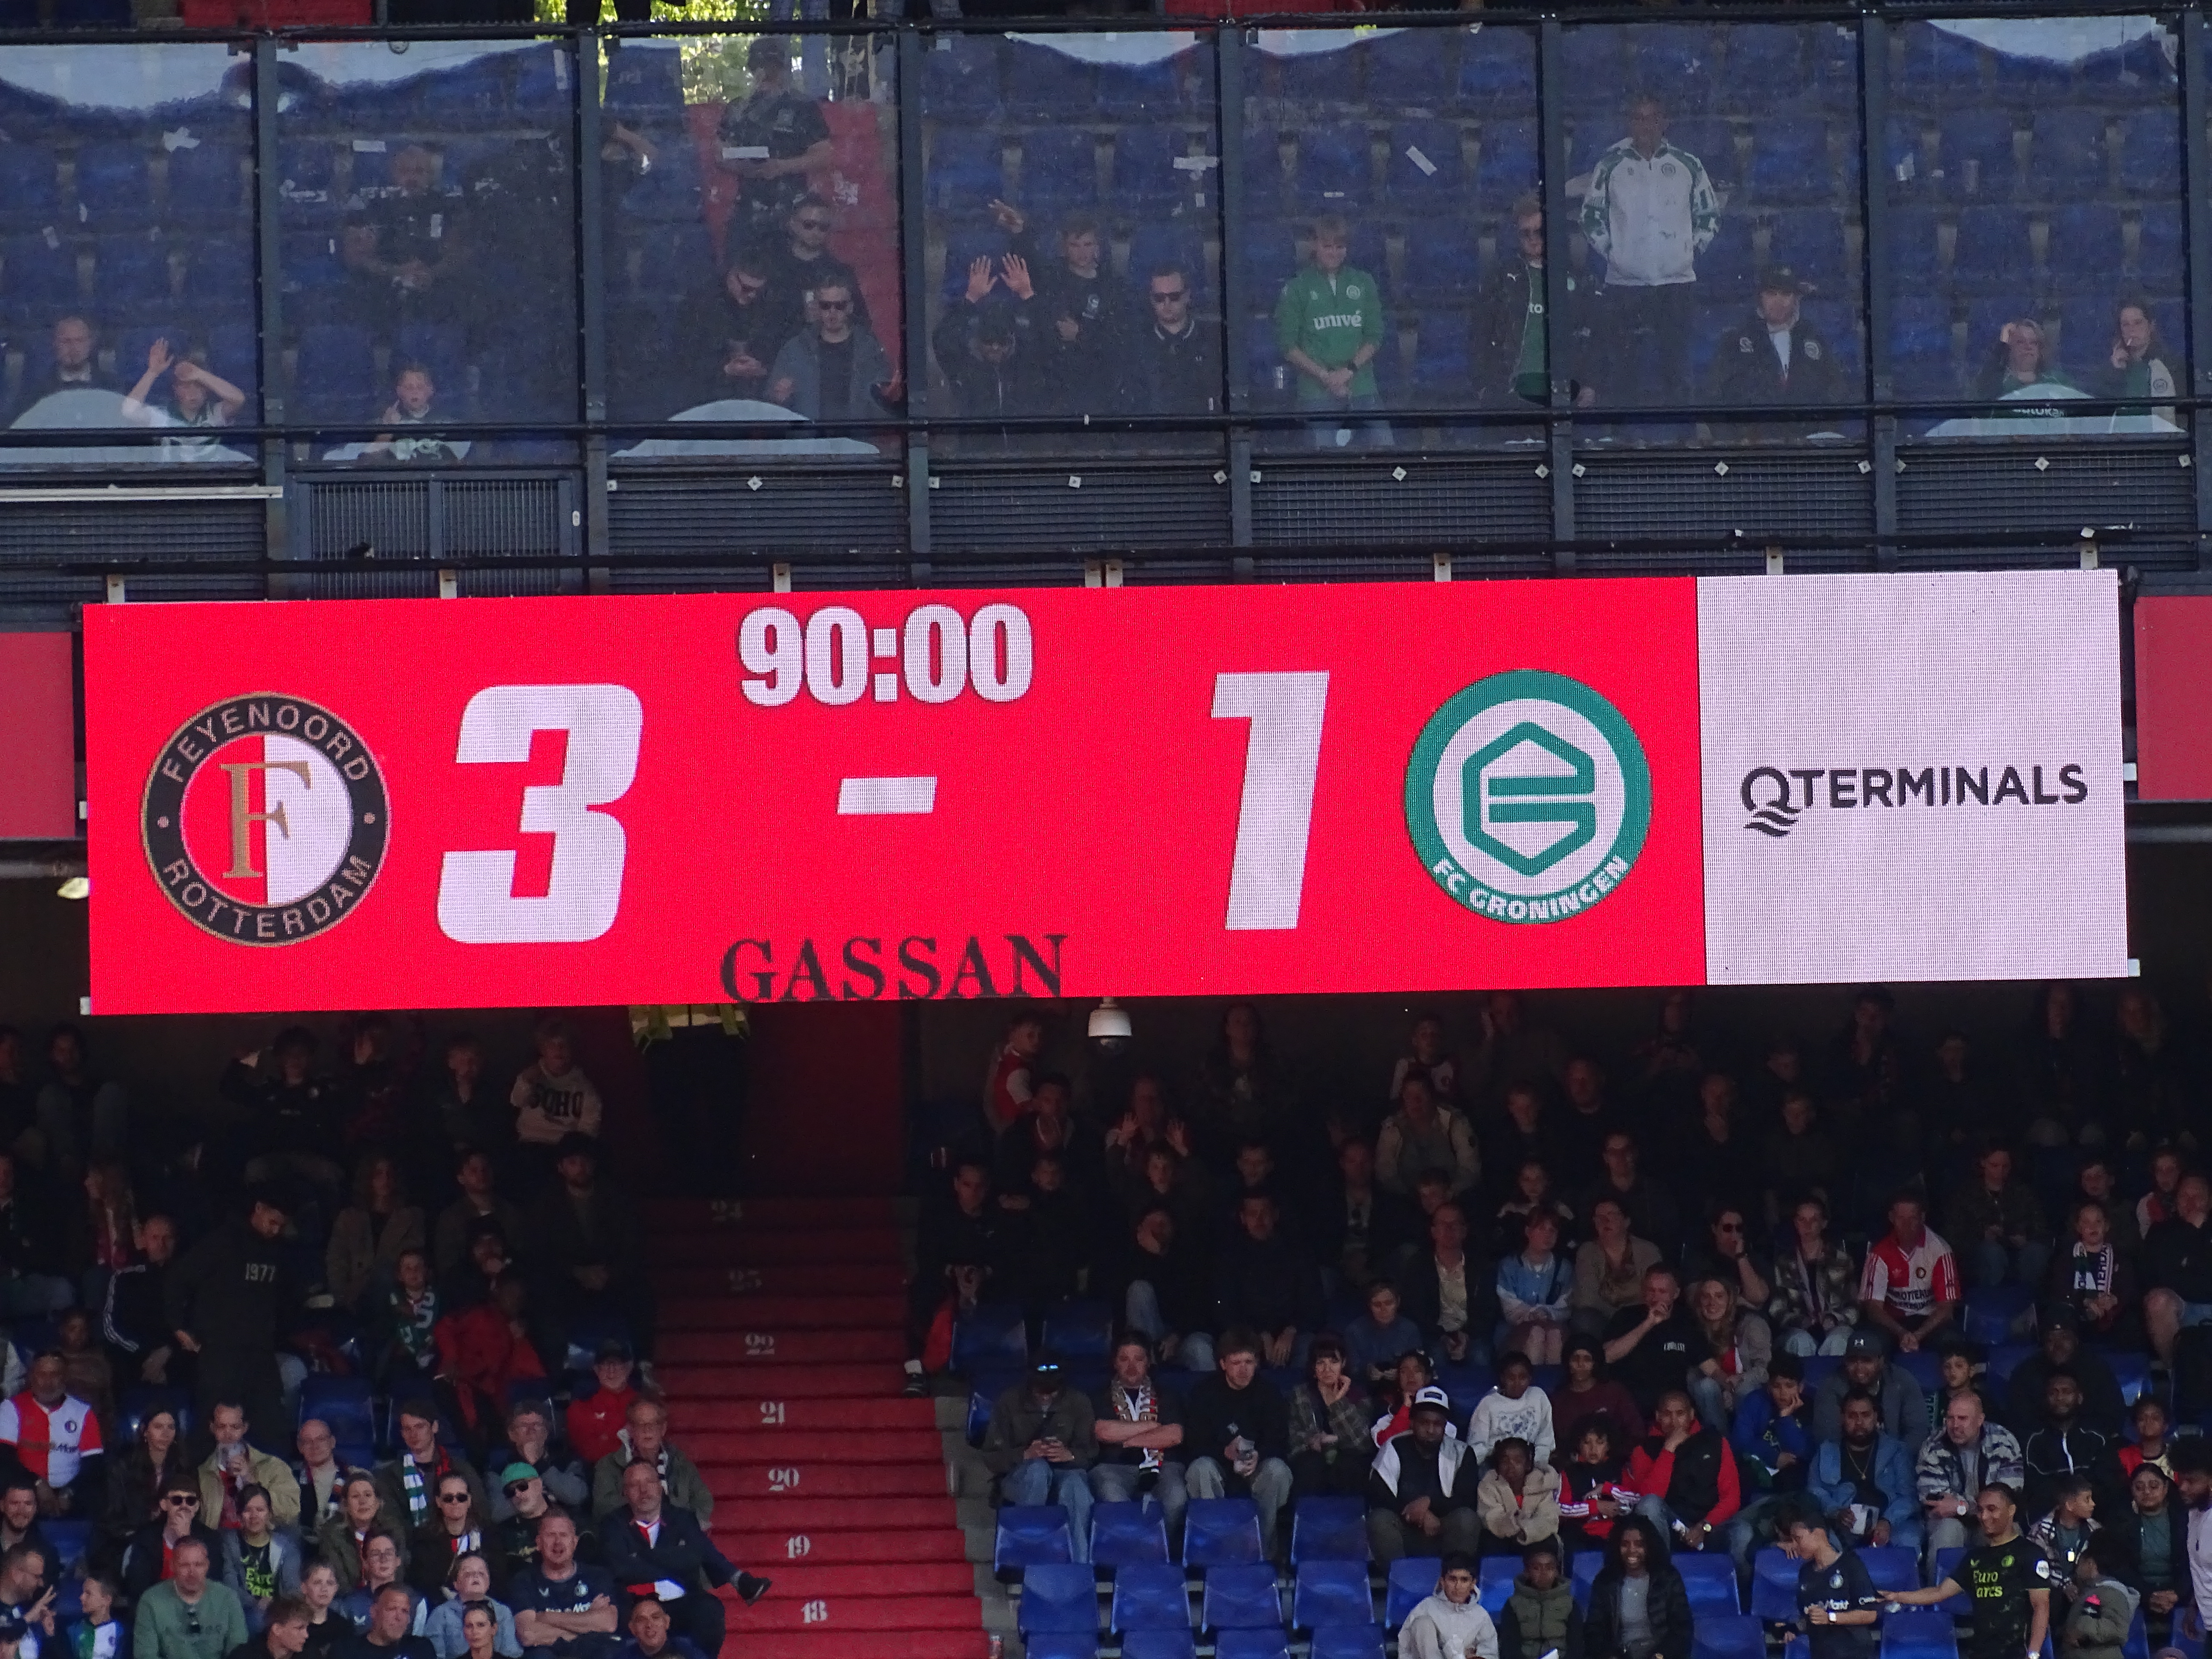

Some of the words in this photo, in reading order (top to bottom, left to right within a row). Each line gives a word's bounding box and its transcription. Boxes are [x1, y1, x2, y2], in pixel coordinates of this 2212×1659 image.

[738, 603, 1034, 707] 90:00
[162, 701, 369, 783] FEYENOORD
[436, 682, 643, 945] 3
[1211, 670, 1330, 931] 1
[1740, 764, 2088, 830] QTERMINALS
[162, 854, 372, 938] ROTTERDAM
[1432, 858, 1467, 893] FC
[1469, 856, 1629, 920] GRONINGEN
[720, 932, 1068, 1003] GASSAN
[245, 1262, 276, 1283] 1977
[745, 1333, 775, 1355] 22
[760, 1400, 786, 1426] 21
[768, 1467, 800, 1492] 20
[784, 1535, 811, 1559] 19
[801, 1599, 829, 1624] 18
[1976, 1585, 2003, 1598] arcs
